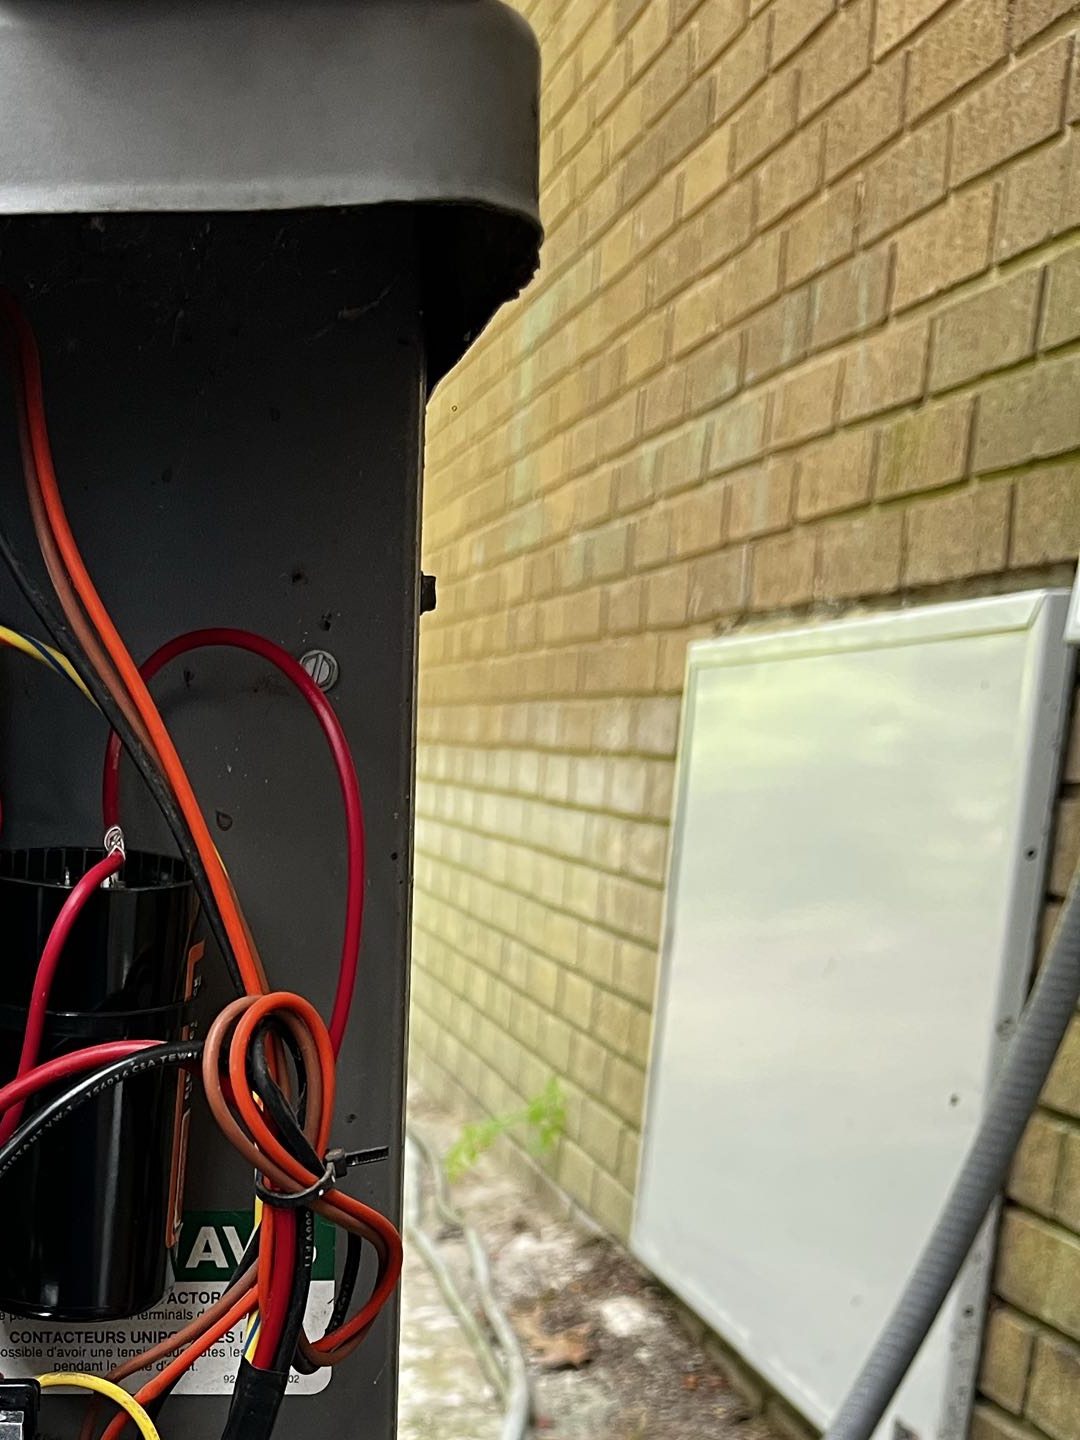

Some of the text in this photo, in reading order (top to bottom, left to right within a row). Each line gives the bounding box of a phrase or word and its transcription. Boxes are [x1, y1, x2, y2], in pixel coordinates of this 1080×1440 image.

[130, 1058, 156, 1073] CSA
[137, 1309, 193, 1320] terminals
[9, 1331, 126, 1344] CONTACTEURS
[47, 1346, 86, 1358] d'avoir
[91, 1349, 113, 1358] une
[54, 1360, 102, 1373] pendant
